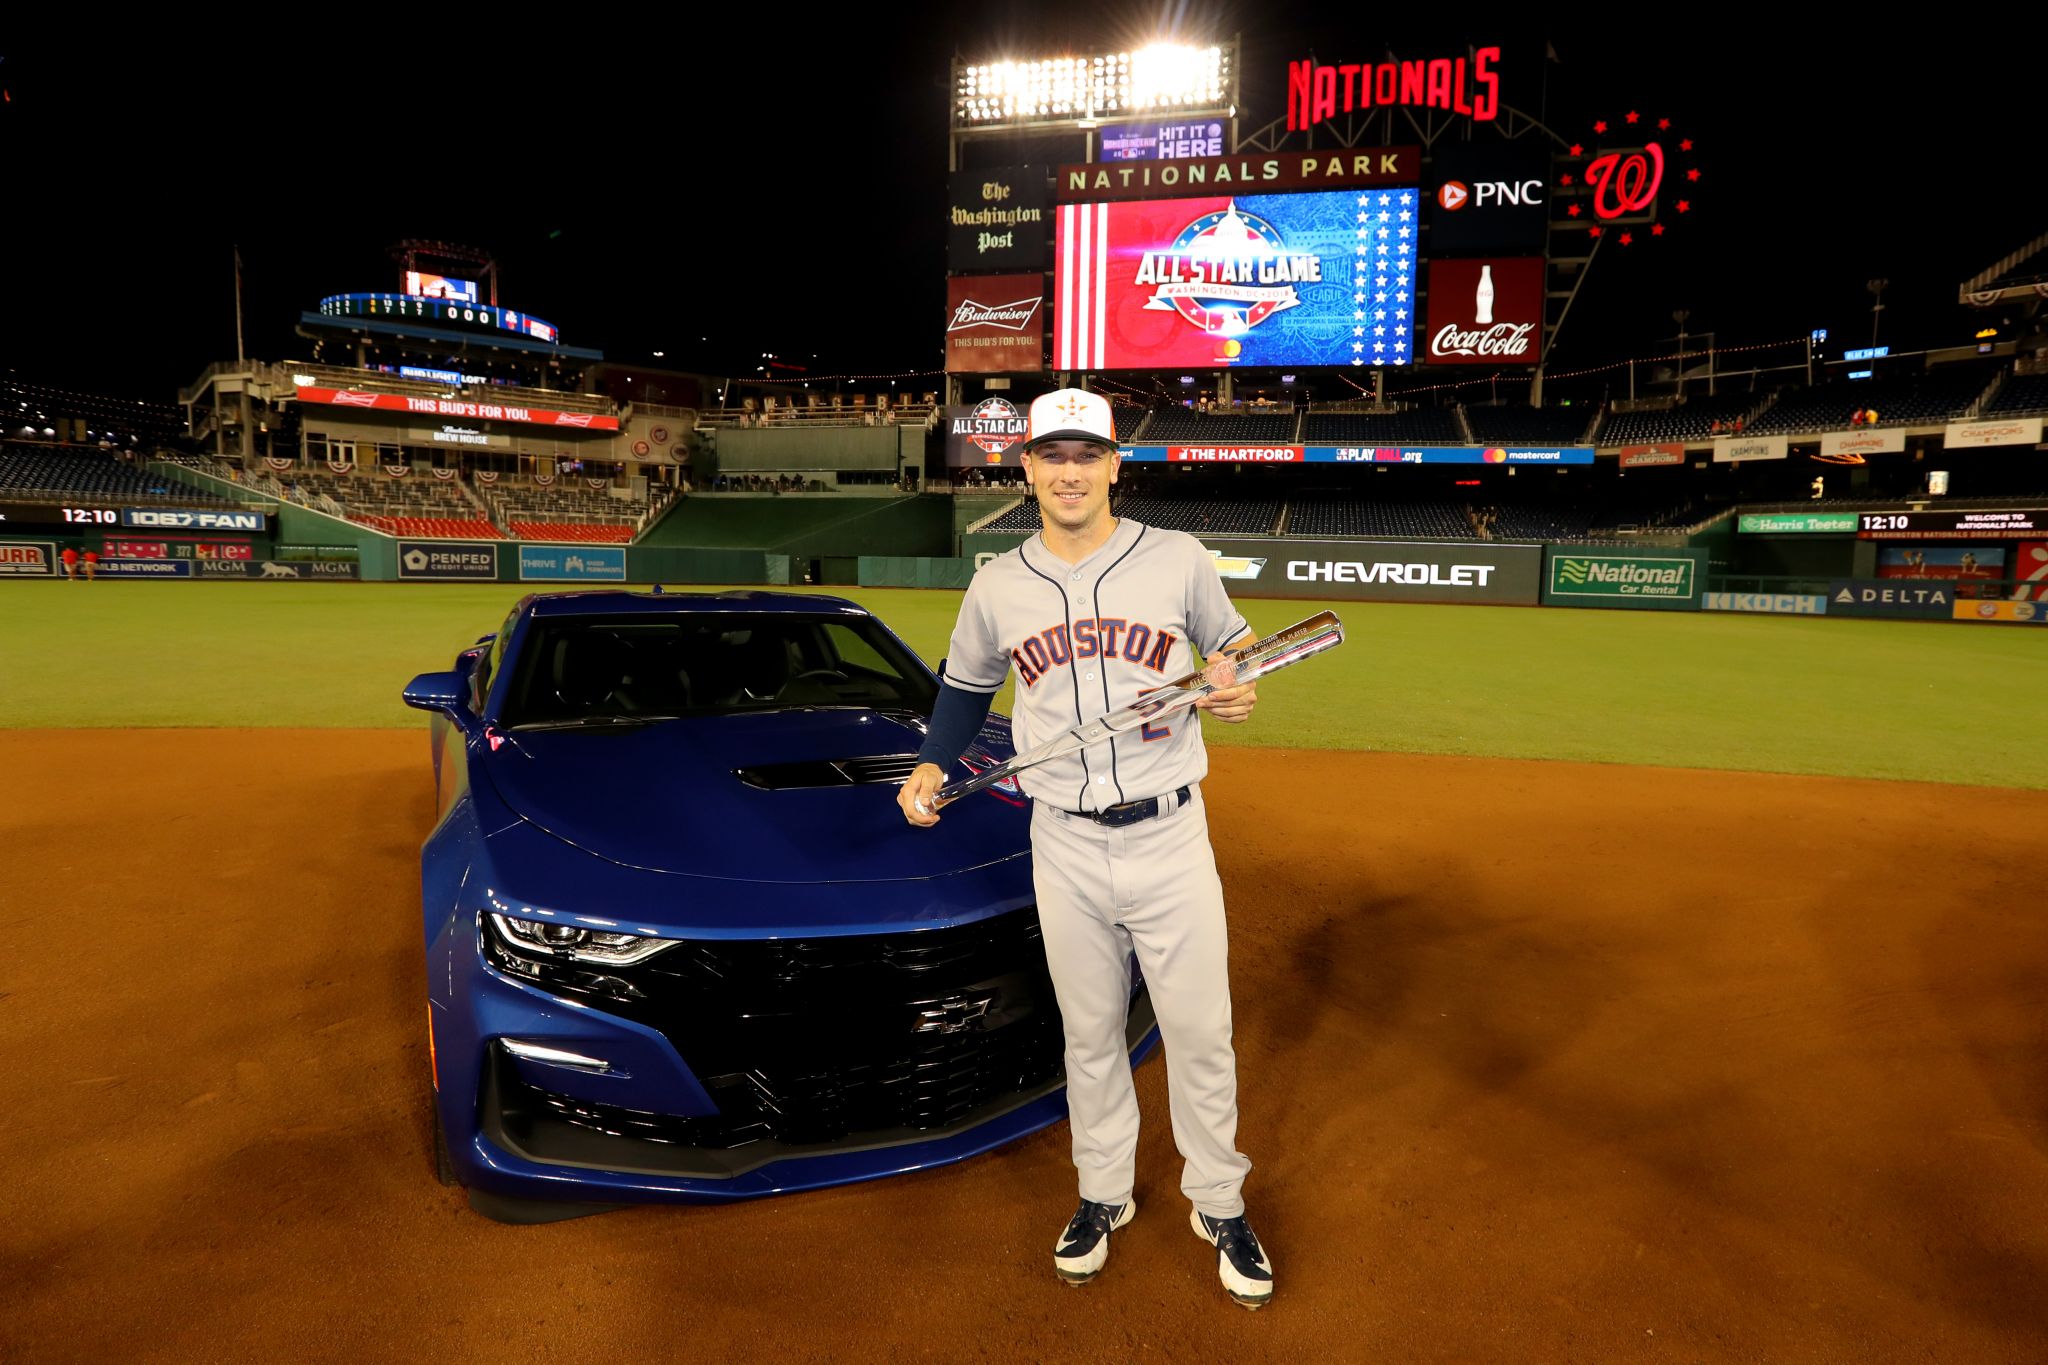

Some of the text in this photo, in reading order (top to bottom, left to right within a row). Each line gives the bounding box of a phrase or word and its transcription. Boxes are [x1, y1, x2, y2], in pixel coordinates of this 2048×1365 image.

[1288, 46, 1500, 131] NATIONALS
[1159, 125, 1206, 141] HIT IT
[1158, 138, 1222, 159] HERE
[1069, 154, 1399, 190] NATIONALS PARK
[981, 181, 1011, 201] The
[1473, 180, 1543, 207] PNC
[951, 205, 1041, 226] Washington
[977, 231, 1013, 253] Post
[1134, 252, 1322, 286] ALL STAR GAME
[448, 307, 489, 324] 0 0 0
[954, 306, 1032, 322] Budweiser
[954, 336, 1035, 347] THIS BUD'S FOR YOU.
[1431, 323, 1535, 356] Coca-Cola
[427, 370, 457, 381] LIGHT
[461, 374, 487, 384] LOFT
[407, 398, 531, 421] THIS BUD'S FOR YOU.
[953, 419, 1028, 434] ALL STAR GA
[1961, 426, 2024, 438] CHAMPIONS
[433, 432, 488, 445] BREW HOUSE
[1839, 439, 1885, 449] CHAMPIONS
[1190, 448, 1294, 461] THE HARTFORD
[1509, 450, 1560, 460] mastercard
[1730, 446, 1769, 457] CHAMPIONS
[1625, 455, 1678, 464] CHAMPIONS
[62, 508, 117, 524] 12:10
[200, 514, 256, 529] FAN
[1863, 516, 1908, 530] 12:10
[1964, 514, 2010, 522] WELCOME
[1759, 519, 1854, 530] Harris Teeter
[0, 547, 38, 563] URR
[431, 553, 490, 564] PENFED
[120, 564, 176, 572] NETWORK
[202, 561, 246, 571] MGM
[311, 563, 350, 573] MGM
[521, 559, 556, 568] THRIVE
[1287, 561, 1495, 586] CHEVROLET
[1587, 562, 1684, 584] National
[1620, 584, 1678, 594] Car Rental
[1862, 589, 1946, 604] DELTA
[1735, 594, 1816, 612] KOCH
[1287, 627, 1308, 640] PLAYER
[1253, 635, 1278, 649] WILLIAMS
[1012, 618, 1177, 689] HOUSTON
